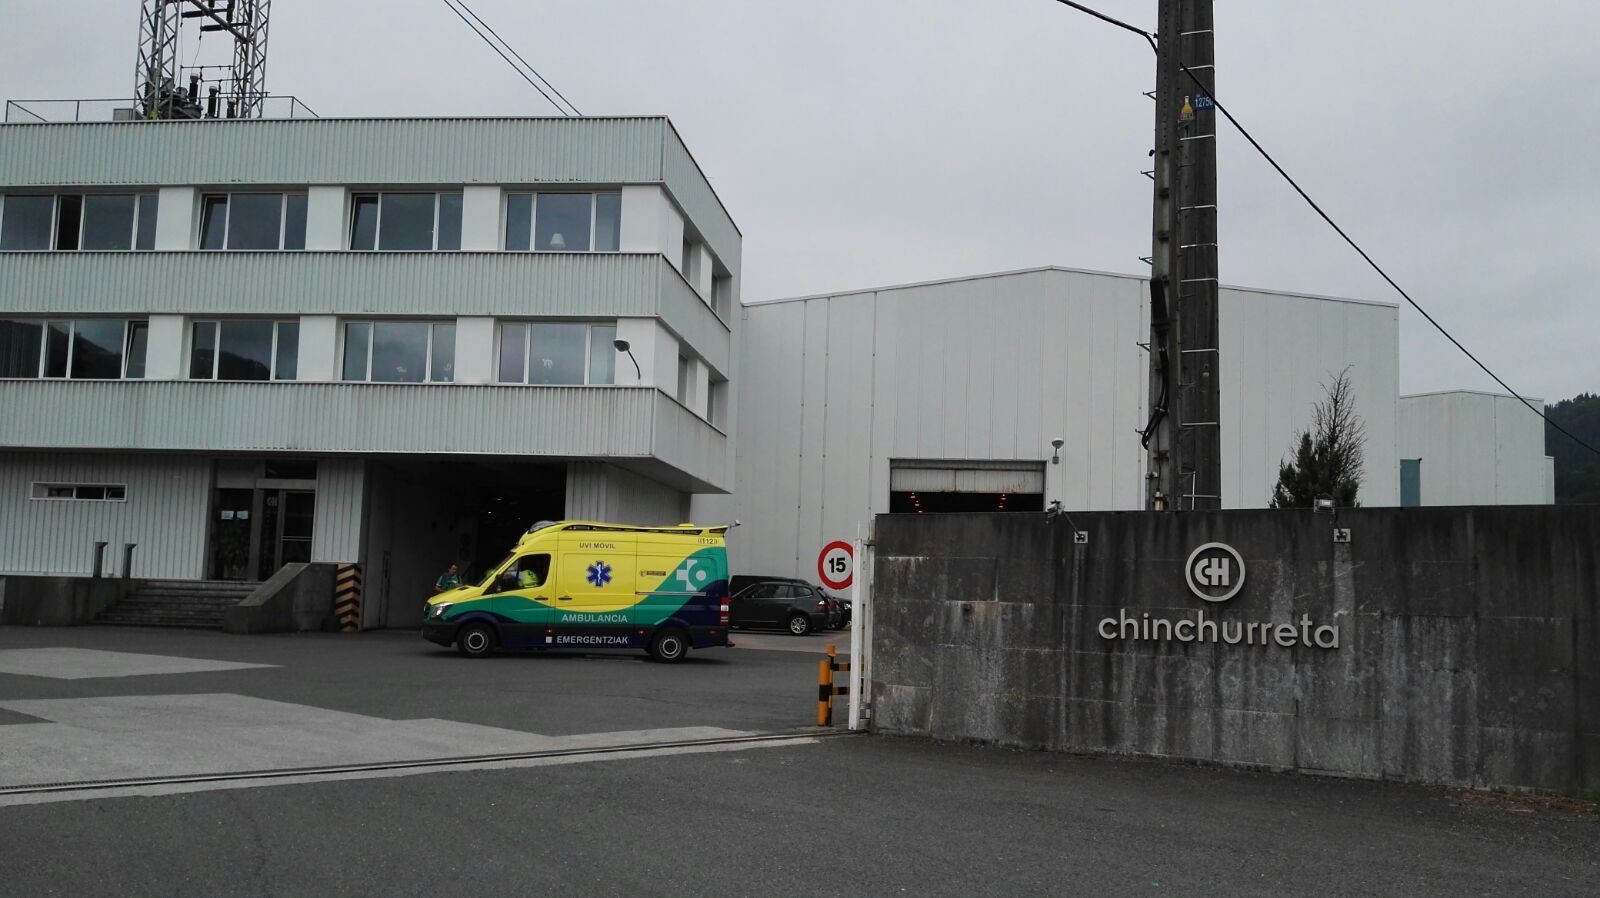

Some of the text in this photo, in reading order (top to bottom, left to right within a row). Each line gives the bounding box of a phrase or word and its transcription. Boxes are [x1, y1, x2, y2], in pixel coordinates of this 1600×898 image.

[828, 557, 846, 573] 15
[561, 613, 628, 623] AMBULANCIA
[1098, 608, 1340, 649] chinchurreta
[556, 635, 629, 644] EMERGENTZIAK
